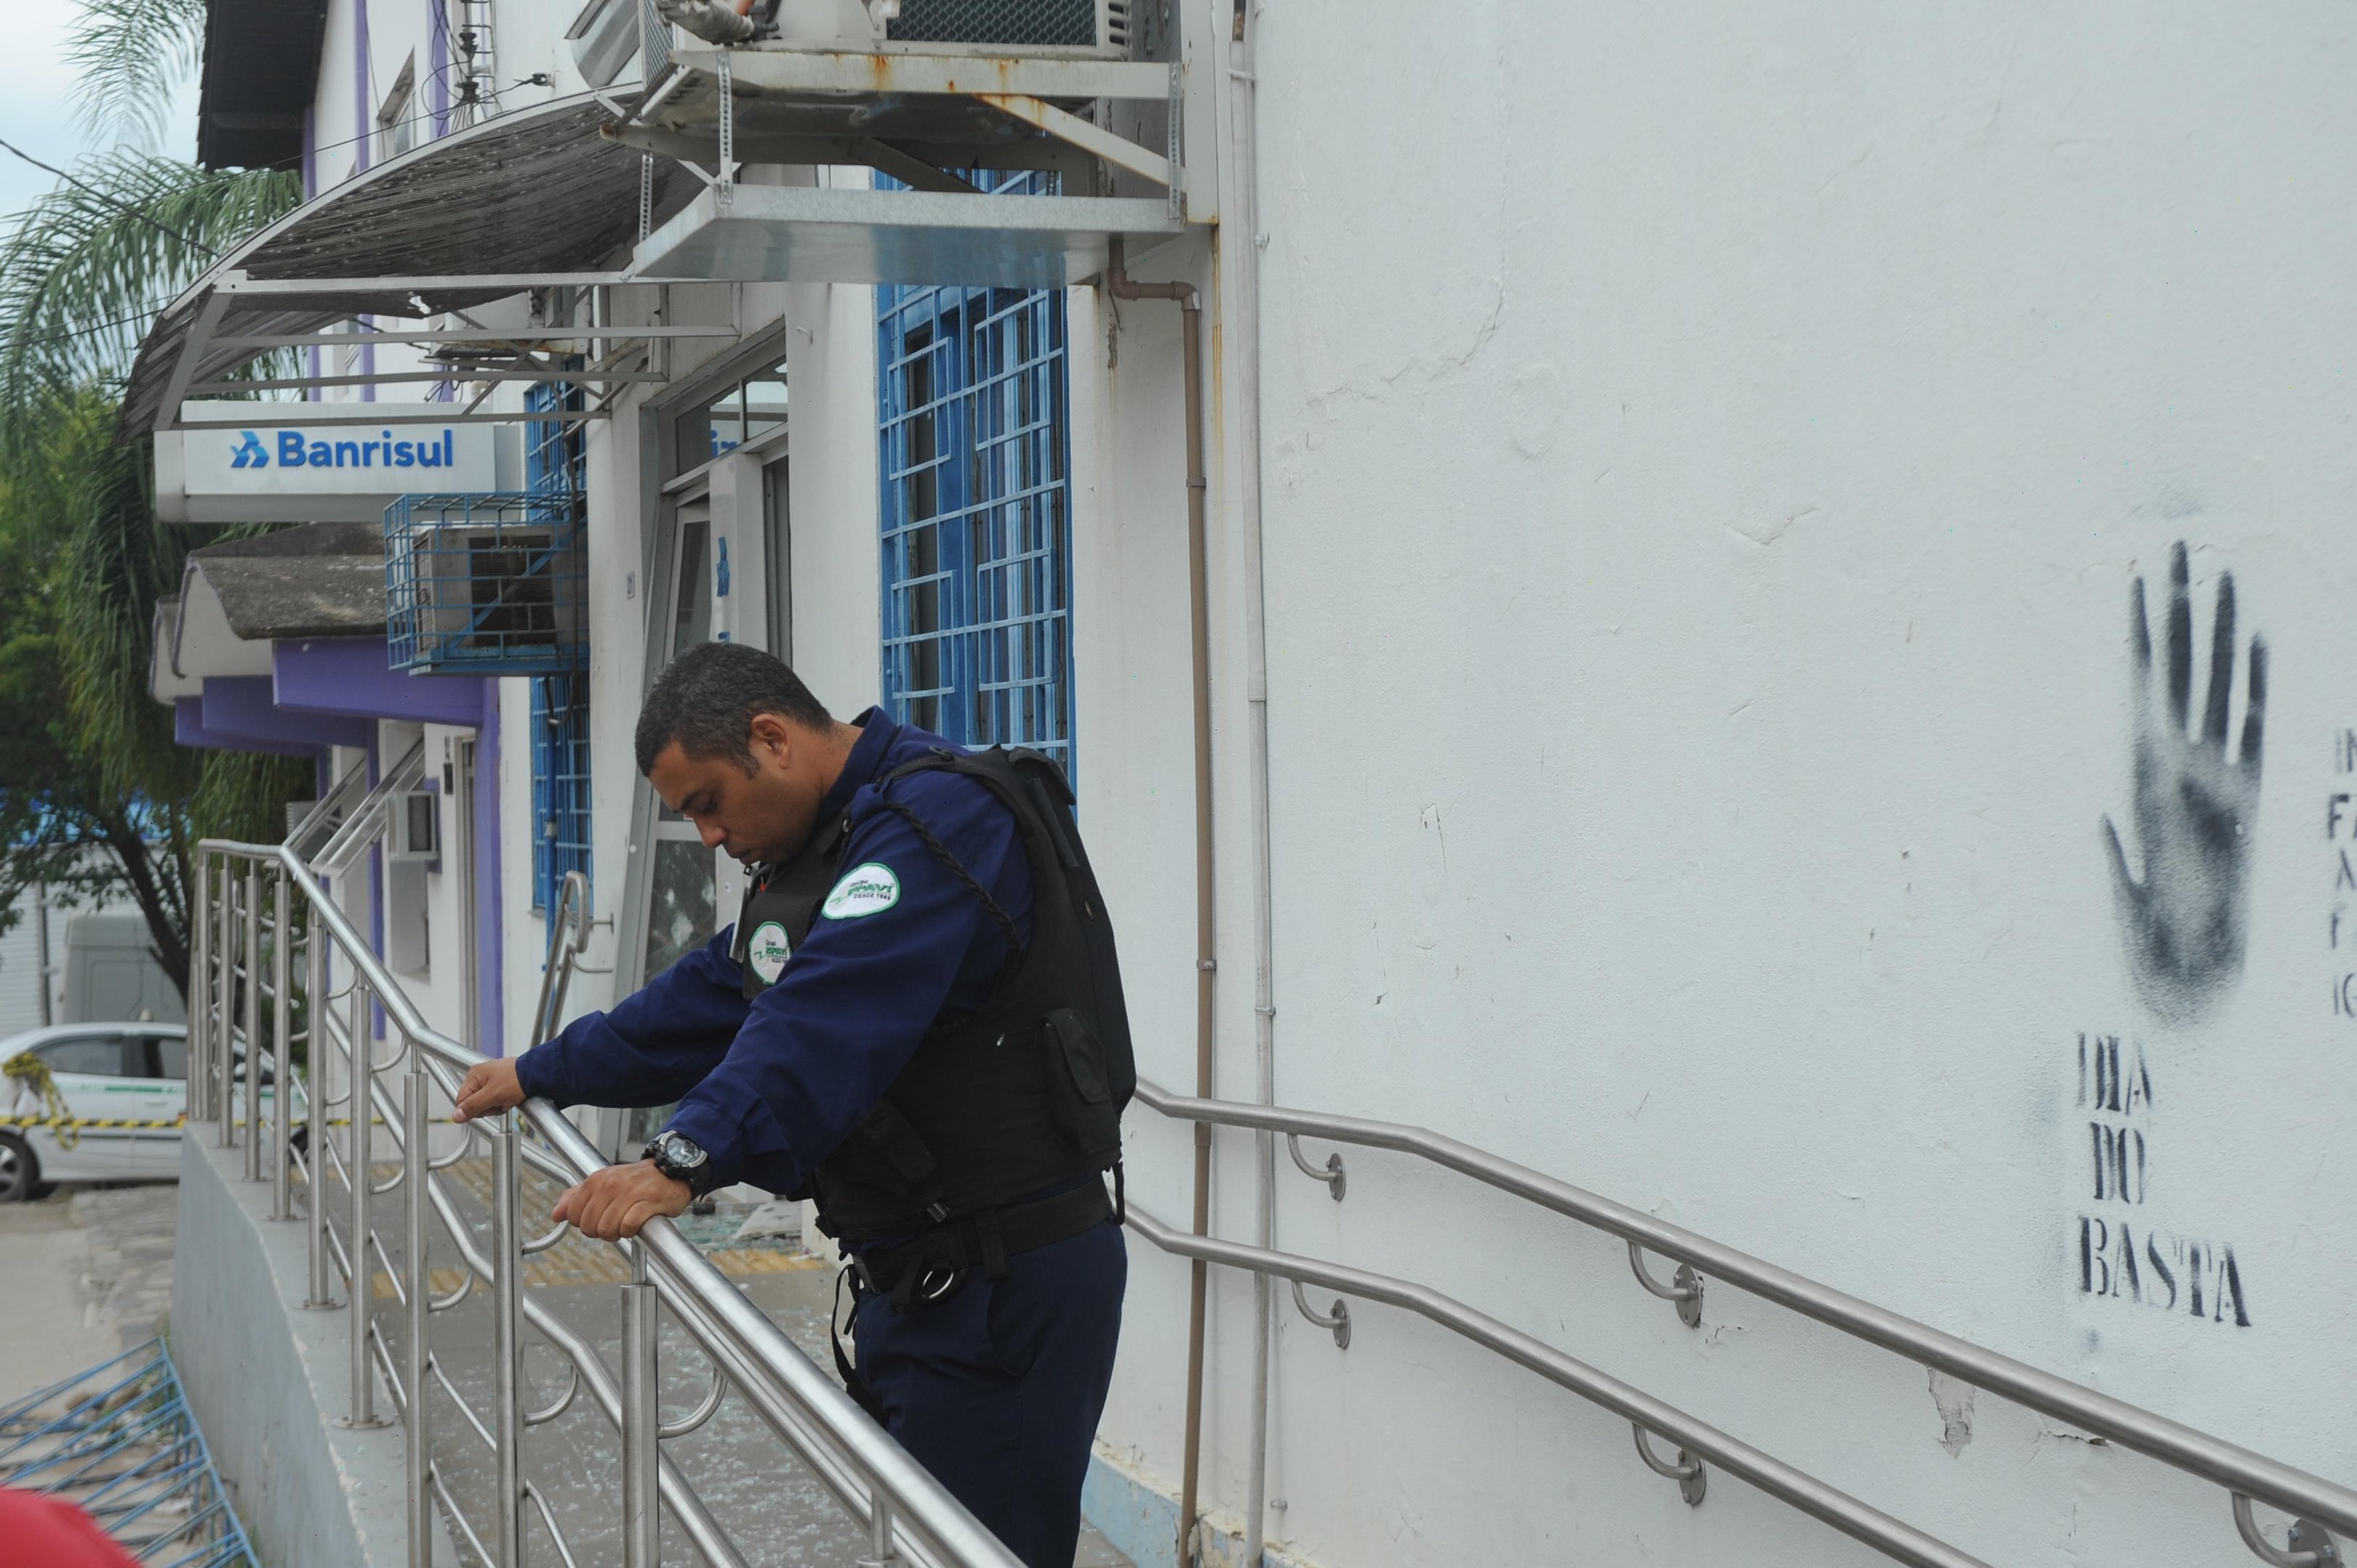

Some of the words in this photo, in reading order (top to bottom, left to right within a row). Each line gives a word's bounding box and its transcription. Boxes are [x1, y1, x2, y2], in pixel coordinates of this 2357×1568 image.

[278, 429, 453, 467] Banrisul
[848, 883, 892, 896] EPAVI
[2076, 1031, 2152, 1115] DIA
[2089, 1122, 2145, 1204] DO
[2077, 1215, 2252, 1327] BASTA
